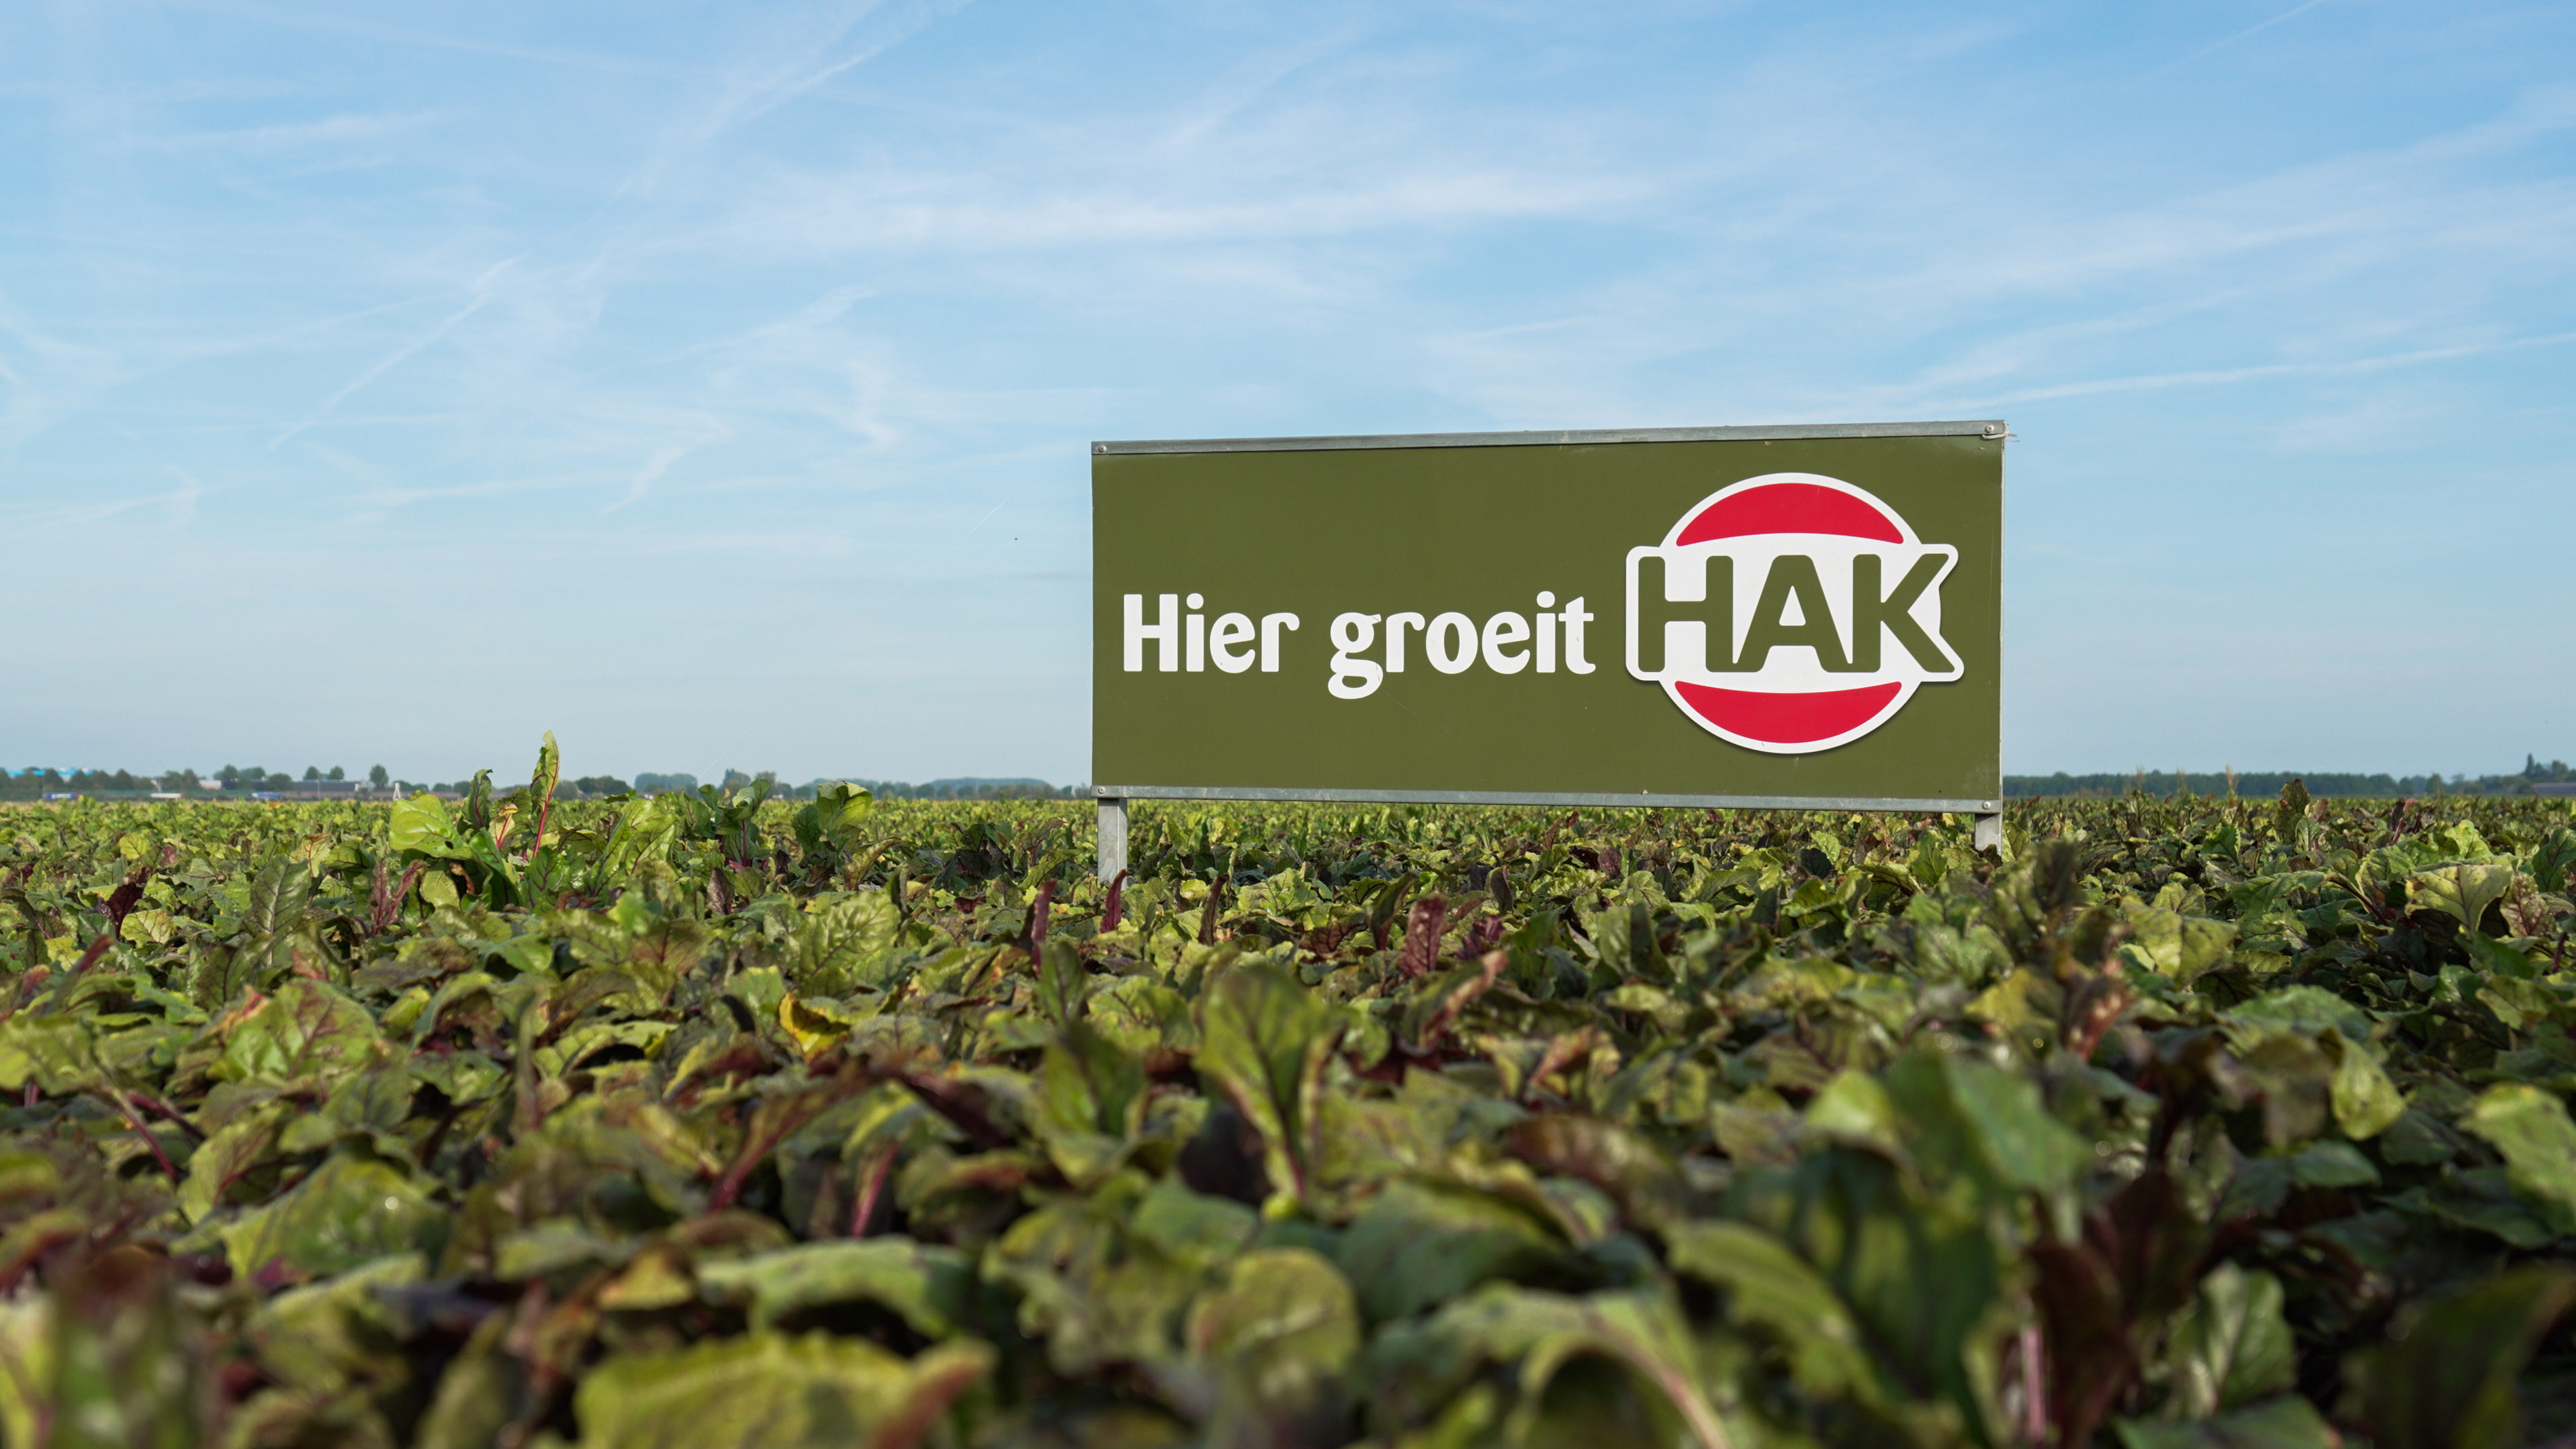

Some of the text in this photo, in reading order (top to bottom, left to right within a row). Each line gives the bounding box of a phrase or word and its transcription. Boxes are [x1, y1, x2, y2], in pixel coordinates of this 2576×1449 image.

[1124, 554, 1955, 699] Hier groeit HAK
